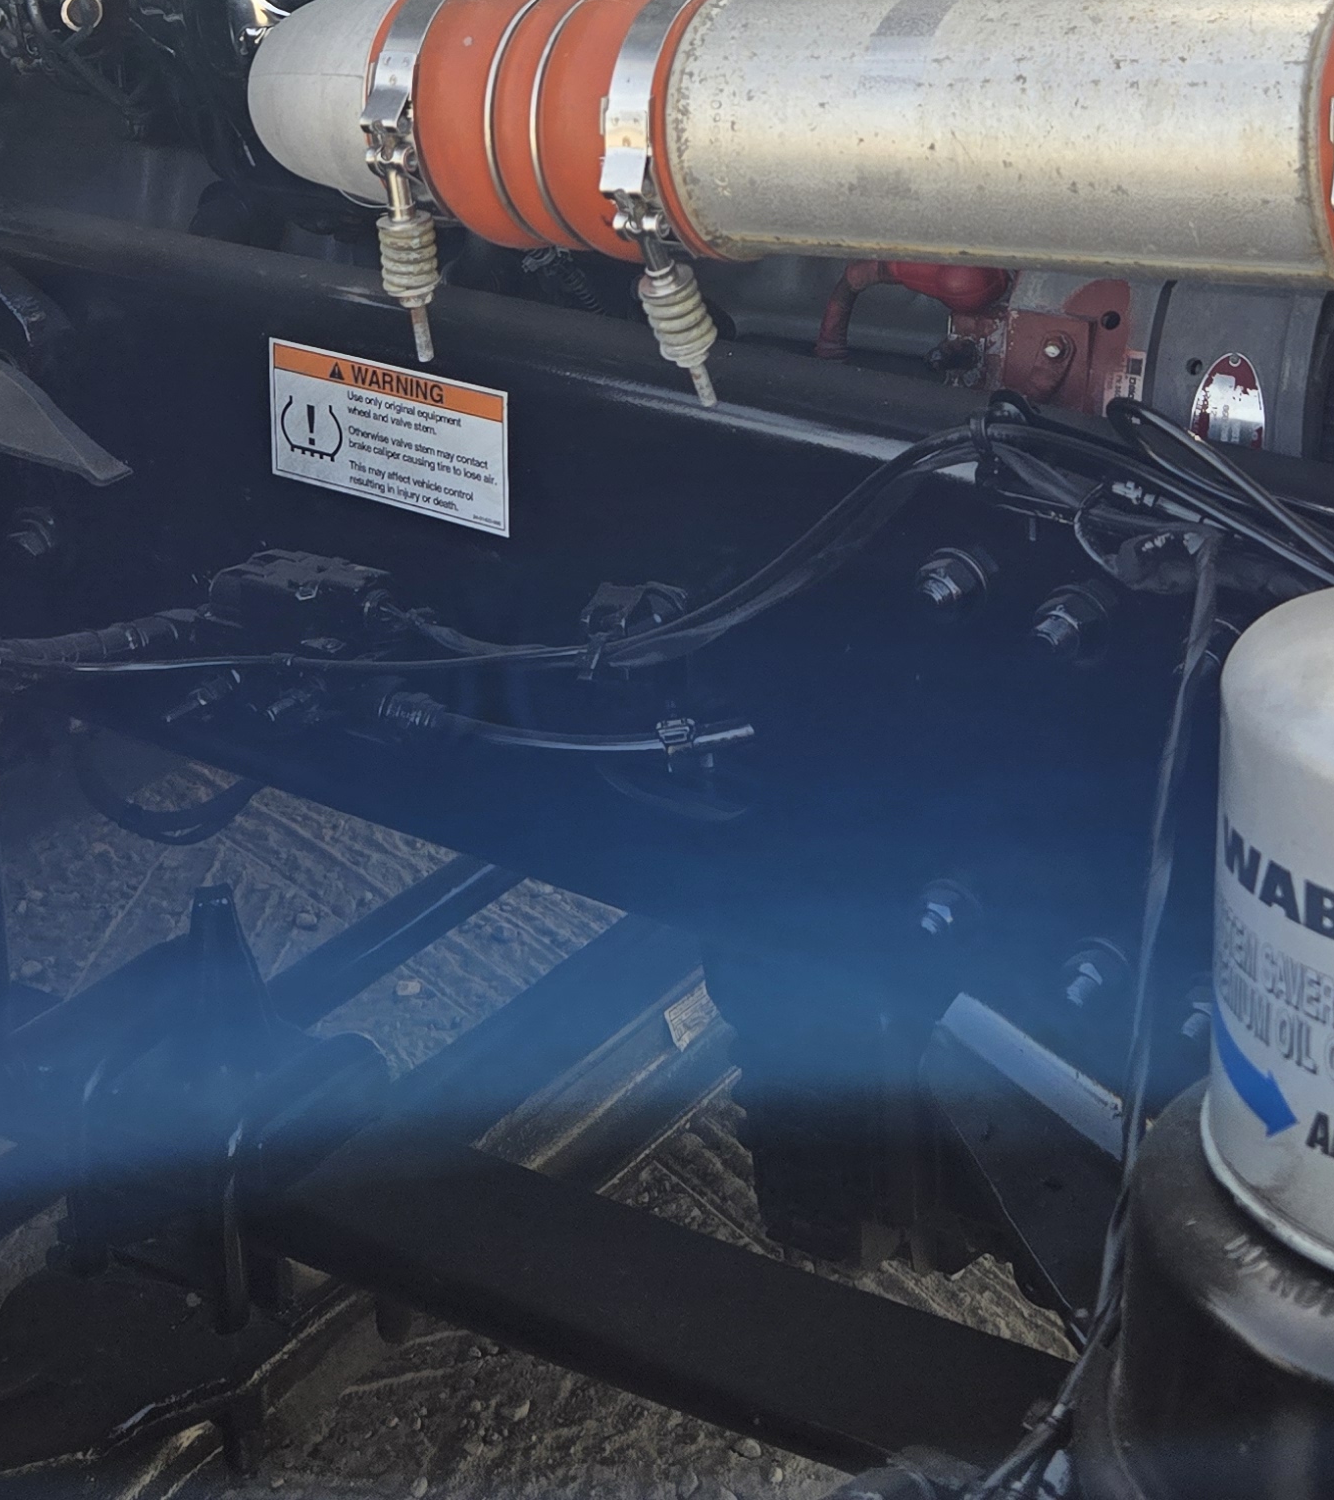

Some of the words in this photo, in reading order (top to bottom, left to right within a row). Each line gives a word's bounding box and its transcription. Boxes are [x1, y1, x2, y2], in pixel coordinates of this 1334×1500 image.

[350, 364, 445, 405] WARNING
[346, 390, 363, 403] Use
[364, 394, 383, 410] only
[384, 399, 416, 415] original
[417, 408, 462, 428] equipment
[346, 405, 371, 419] wheel
[372, 412, 389, 423] and
[390, 416, 413, 430] valve
[413, 421, 437, 436] stem.
[348, 425, 389, 445] Otherwise
[390, 436, 413, 450] valve
[414, 443, 436, 457] stem
[436, 449, 455, 464] may
[456, 453, 489, 470] contact
[348, 438, 372, 453] brake
[373, 445, 401, 461] caliper
[402, 454, 436, 472] causing
[437, 462, 452, 474] tire
[452, 465, 462, 477] to
[463, 467, 482, 482] lose
[483, 473, 498, 486] air.
[348, 459, 367, 474] This
[368, 466, 386, 480] may
[387, 470, 411, 485] affect
[411, 477, 443, 493] vehicle
[443, 485, 474, 502] control
[349, 475, 386, 494] resulting
[387, 483, 396, 495] in
[396, 485, 421, 503] injury
[421, 494, 432, 504] or
[432, 496, 459, 512] death.
[1275, 1006, 1318, 1077] OIL
